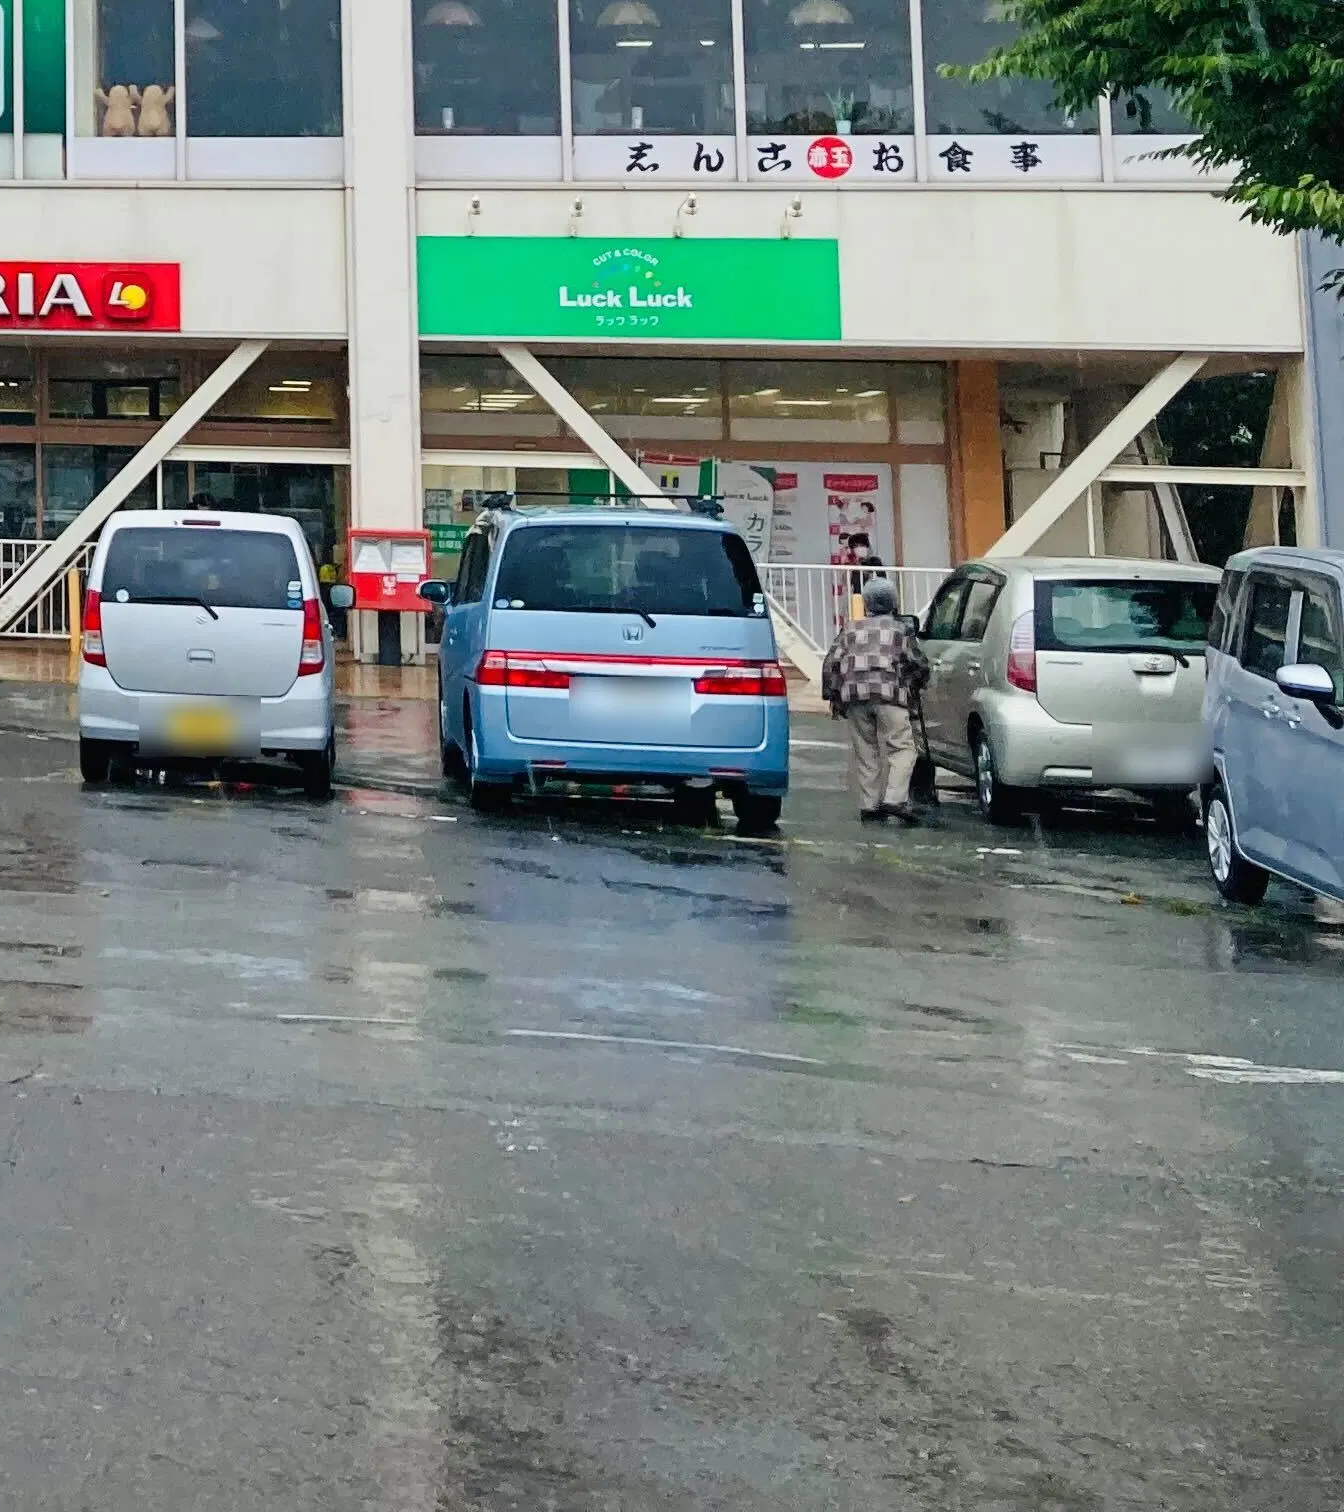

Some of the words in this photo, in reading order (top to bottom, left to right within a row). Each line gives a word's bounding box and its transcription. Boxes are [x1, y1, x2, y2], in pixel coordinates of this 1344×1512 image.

[592, 251, 613, 266] CUT
[623, 248, 659, 267] COLOR
[559, 286, 622, 308] Luck
[629, 285, 693, 308] Luck
